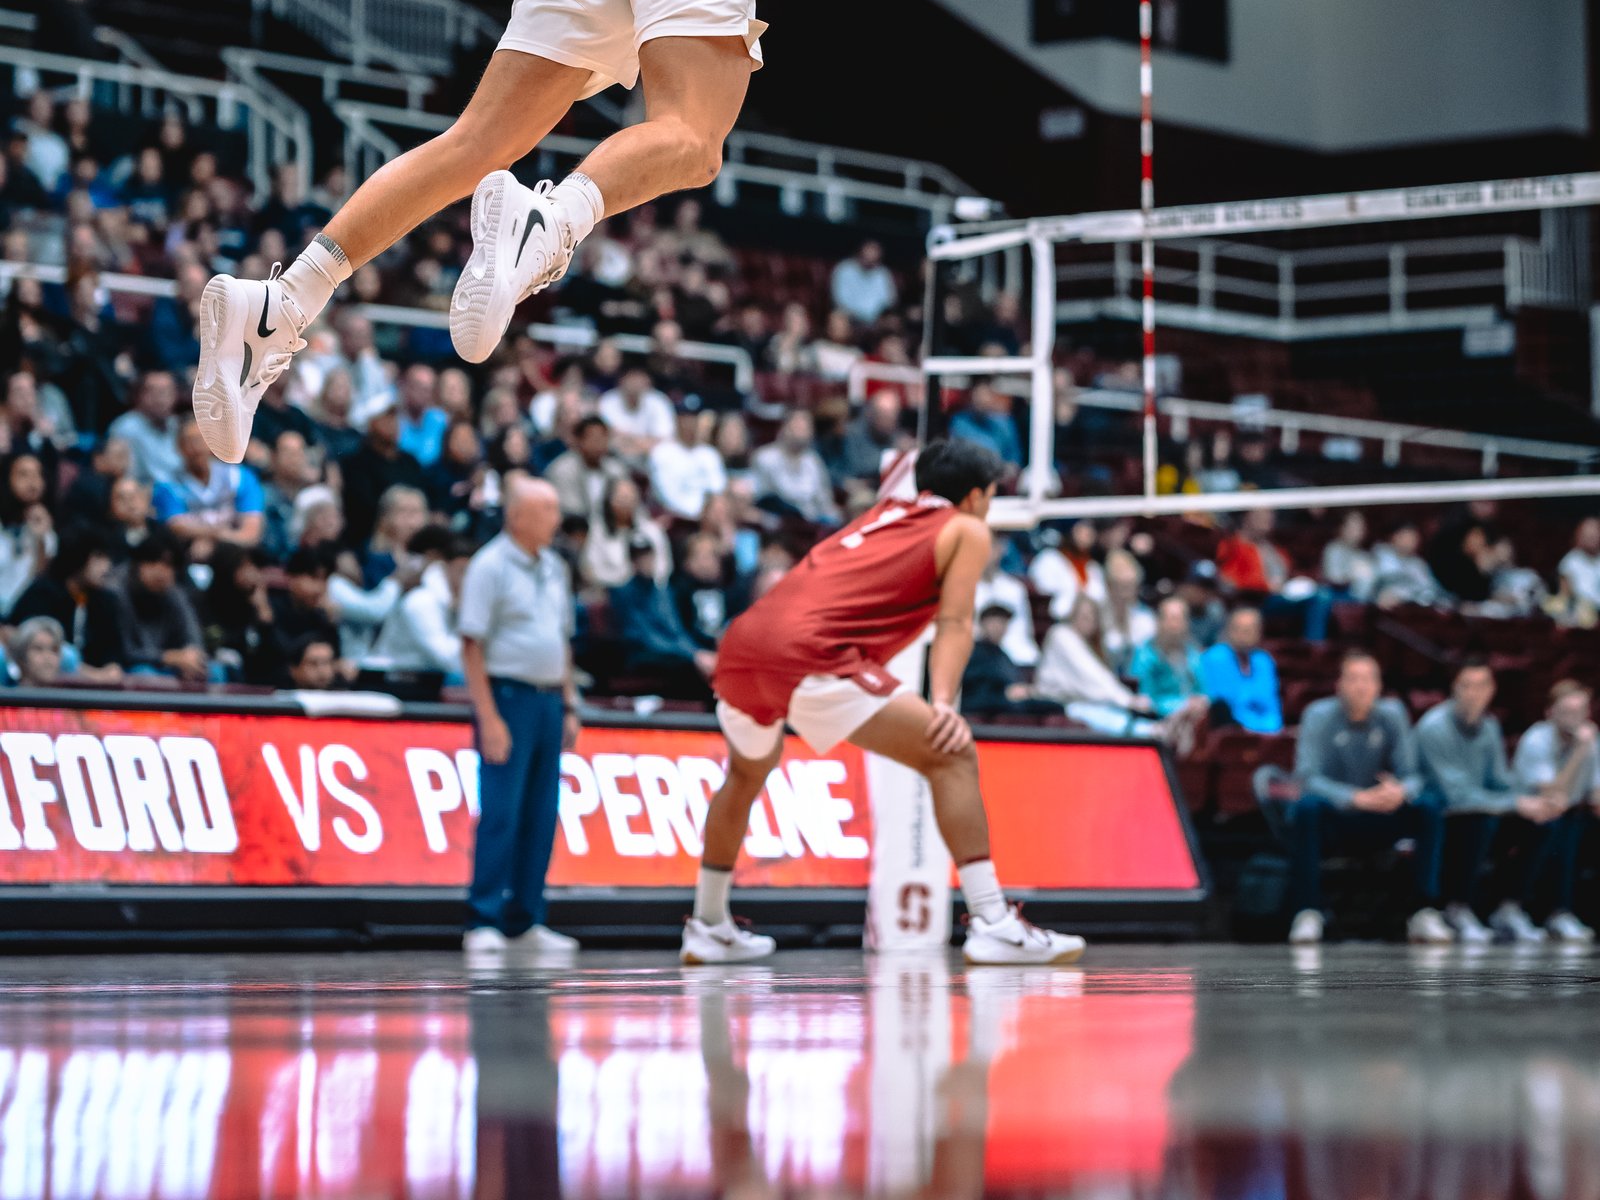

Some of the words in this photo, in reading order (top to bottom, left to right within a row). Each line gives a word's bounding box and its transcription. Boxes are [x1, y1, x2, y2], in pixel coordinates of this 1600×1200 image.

[0, 732, 240, 853] FORD
[262, 743, 382, 853] VS
[405, 747, 869, 859] PPERDINE
